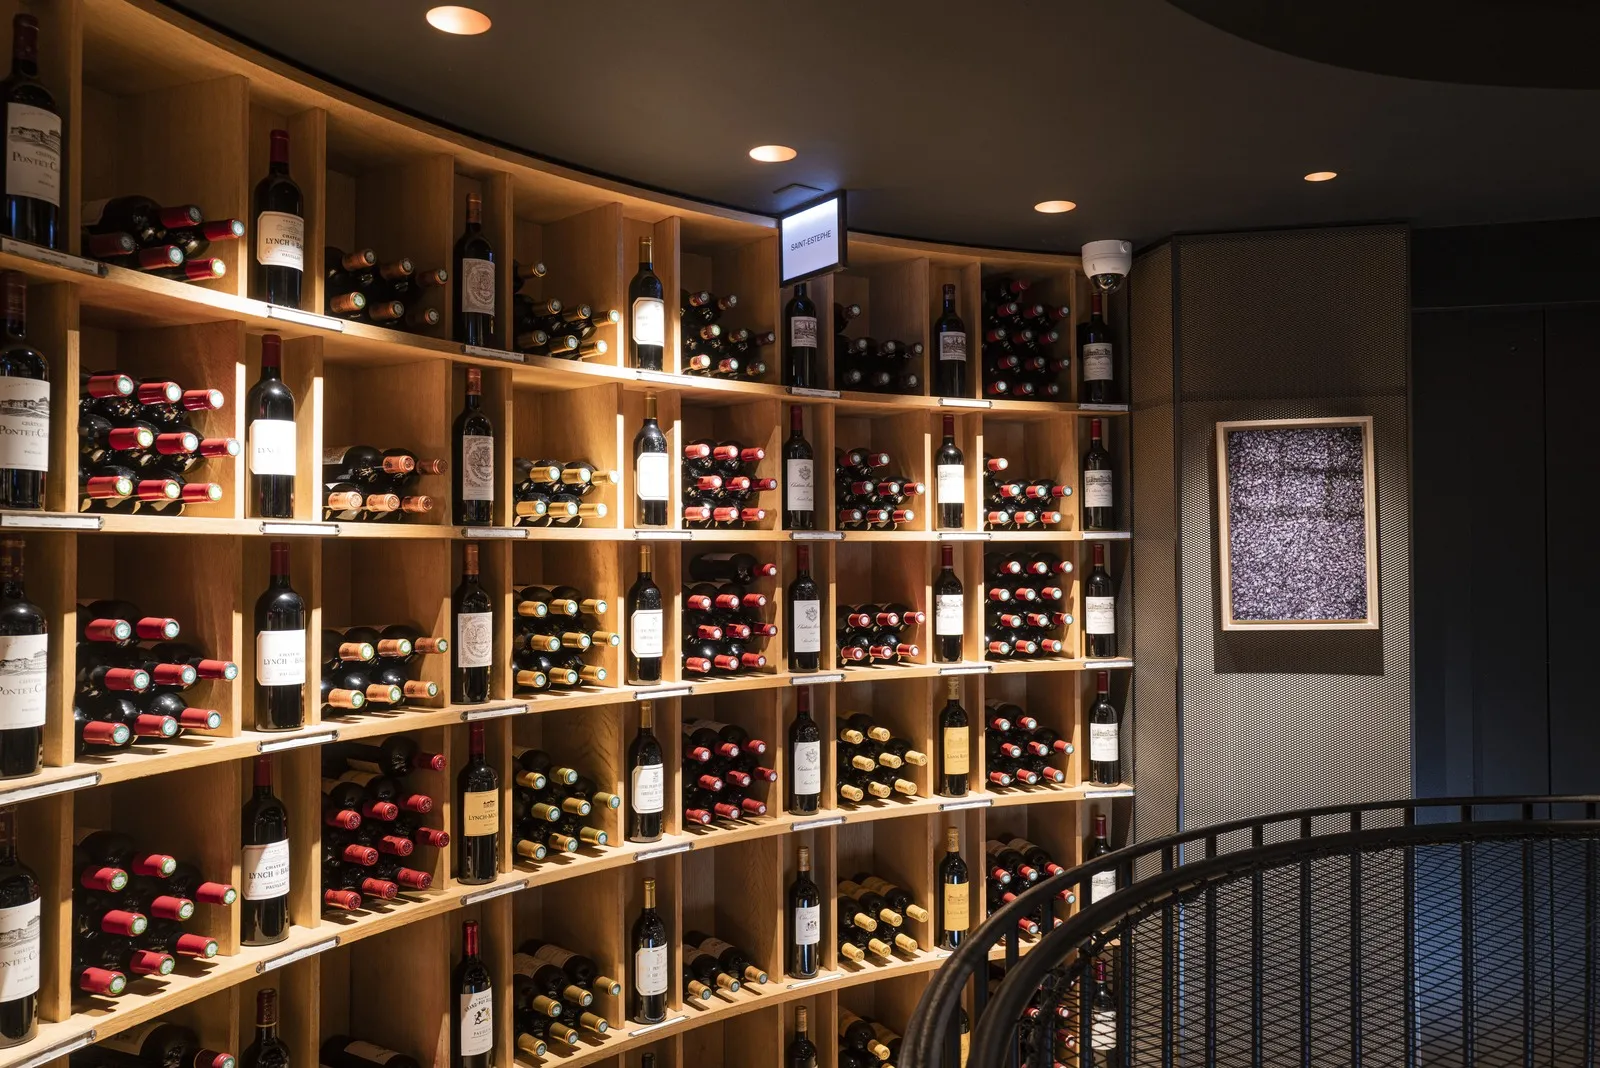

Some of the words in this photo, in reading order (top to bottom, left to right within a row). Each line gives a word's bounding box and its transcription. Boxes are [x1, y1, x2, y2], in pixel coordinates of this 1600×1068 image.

[265, 237, 290, 246] LYNCH
[790, 229, 832, 252] SAINT-ESTEPHE
[248, 871, 274, 880] LYNCH
